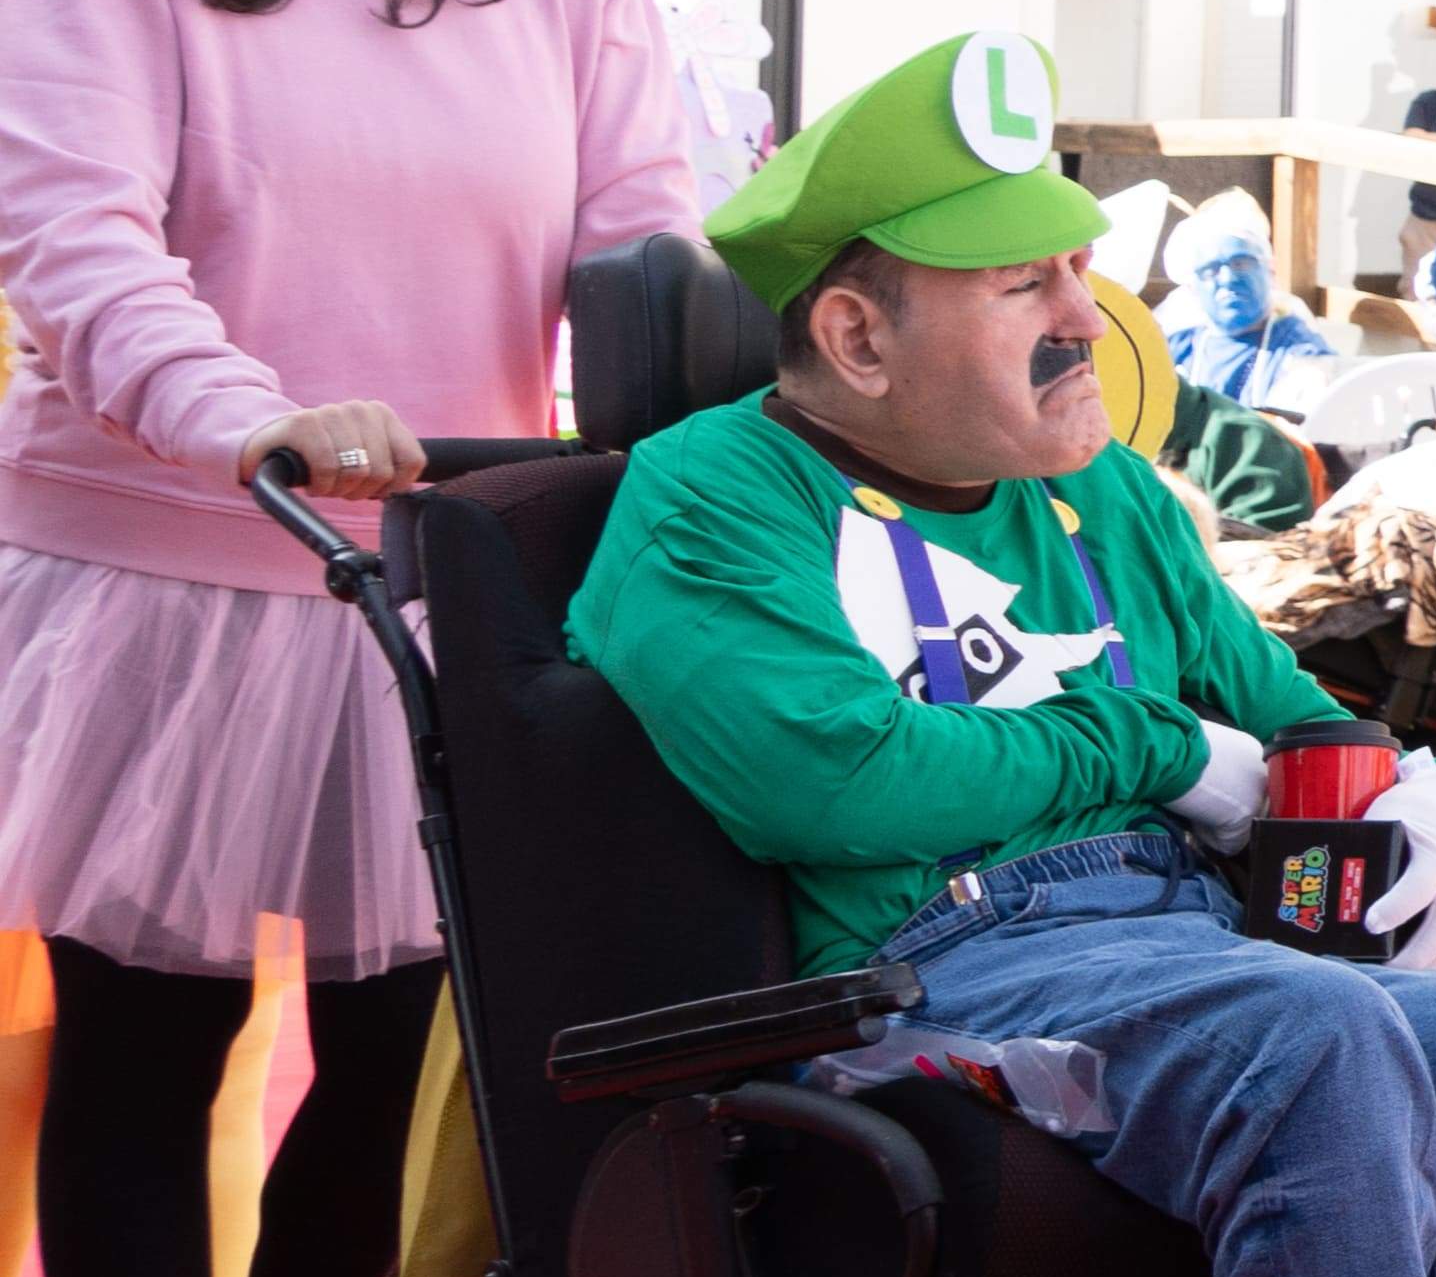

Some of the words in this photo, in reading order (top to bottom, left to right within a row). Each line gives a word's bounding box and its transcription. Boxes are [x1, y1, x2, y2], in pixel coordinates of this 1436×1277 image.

[986, 47, 1038, 141] L
[1278, 855, 1304, 922] SUPER
[1295, 846, 1331, 933] MARIO
